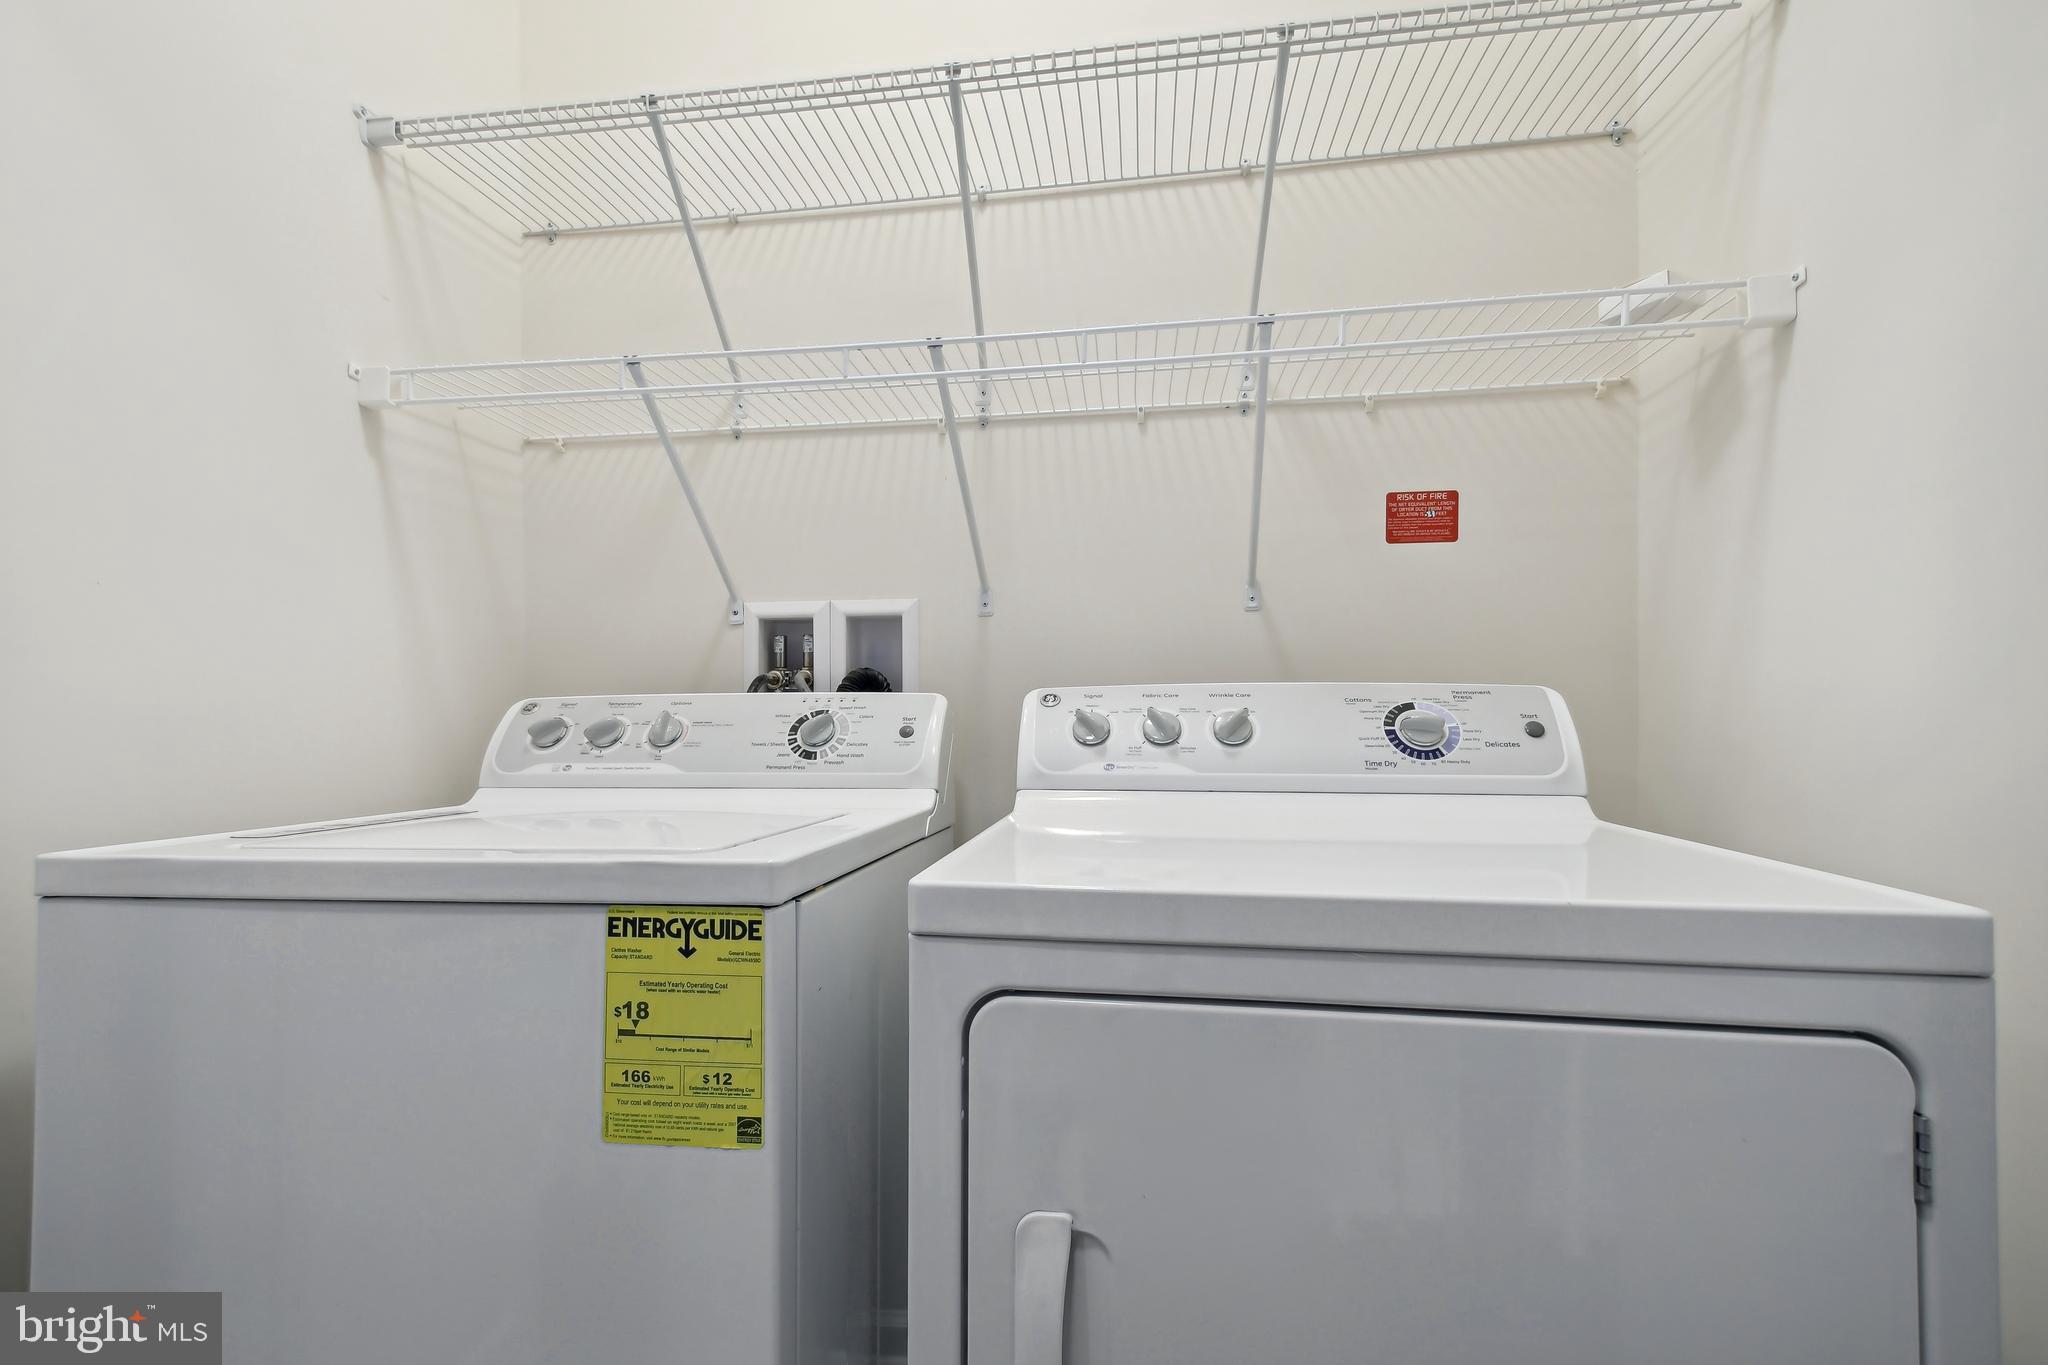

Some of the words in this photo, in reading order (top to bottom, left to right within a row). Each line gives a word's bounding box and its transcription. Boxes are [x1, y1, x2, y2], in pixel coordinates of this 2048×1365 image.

[1396, 493, 1414, 501] RISK
[1416, 493, 1427, 501] OF
[1429, 492, 1448, 500] FIRE
[1384, 760, 1398, 768] Dry
[608, 916, 762, 945] ENERGYGUIDE
[639, 980, 666, 988] Estimated
[667, 981, 685, 989] Yearly
[686, 982, 714, 990] Operating
[614, 1000, 650, 1020] $18
[621, 1069, 650, 1083] 166
[652, 1100, 673, 1108] depend
[710, 1102, 724, 1110] rates
